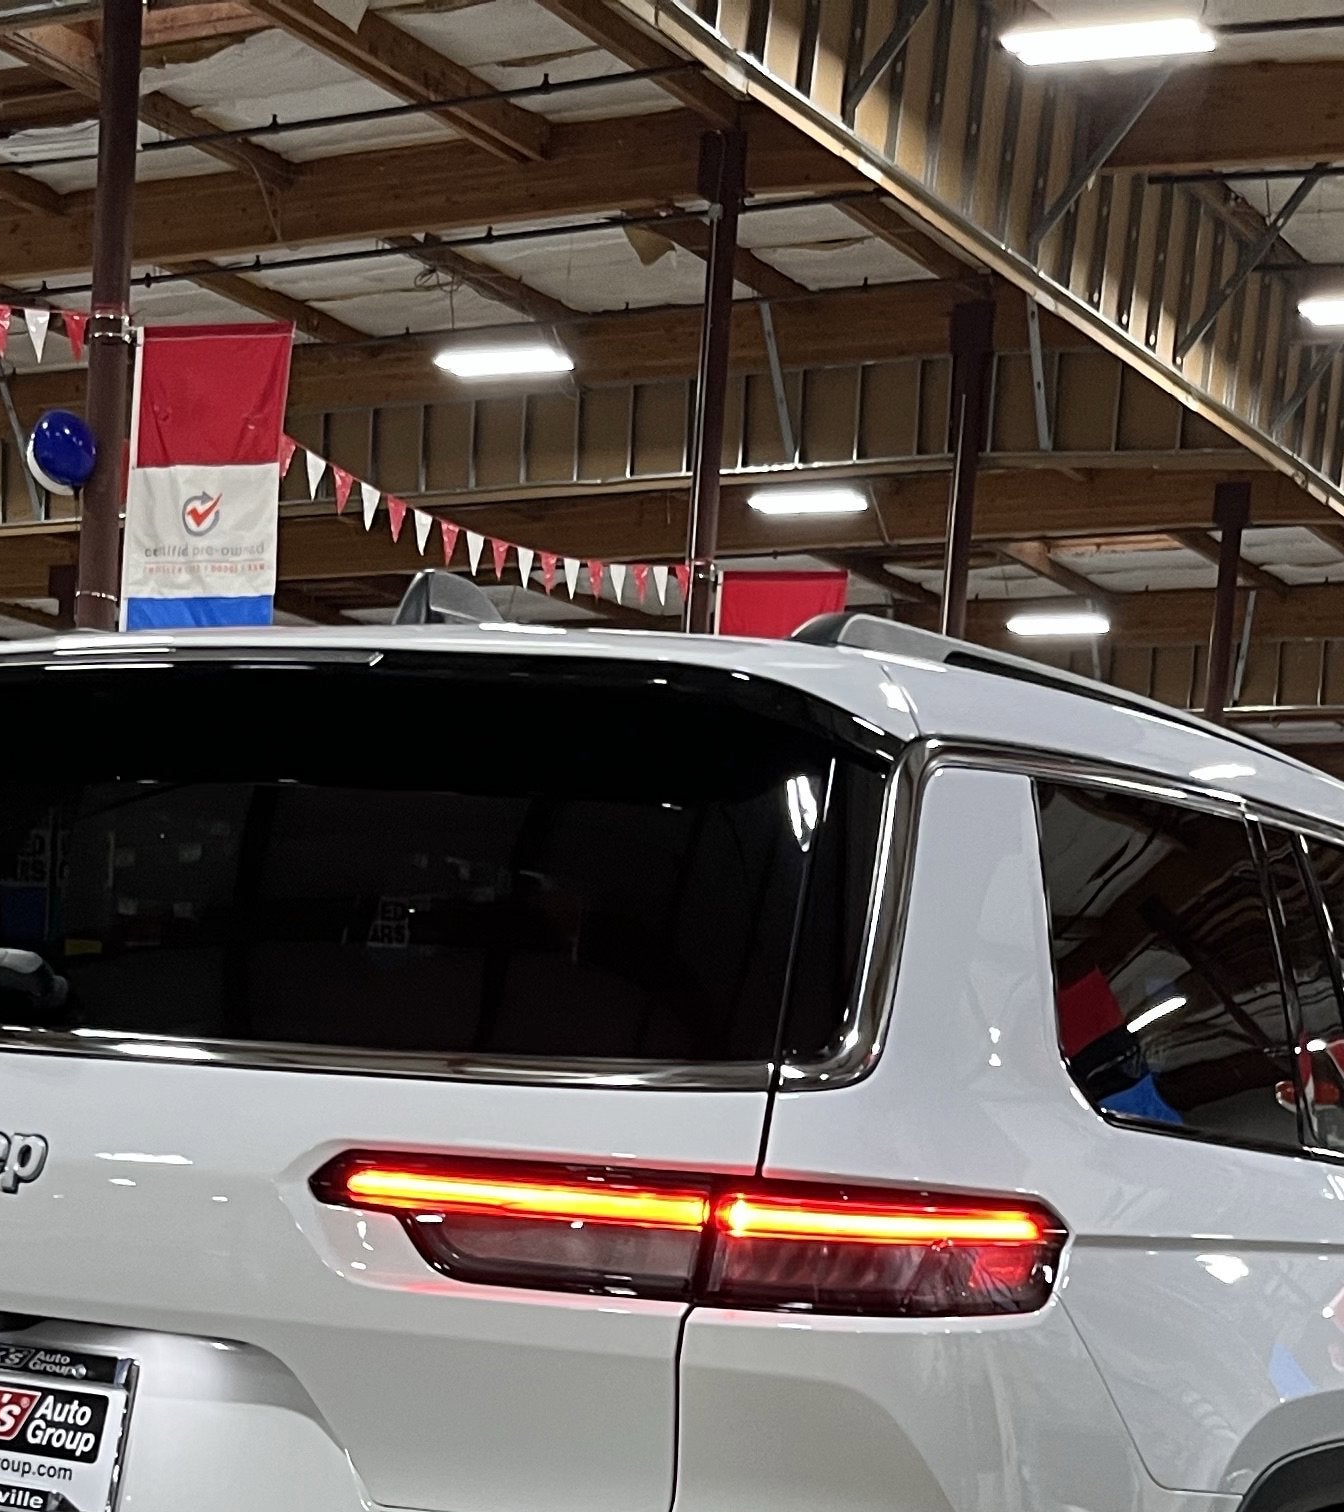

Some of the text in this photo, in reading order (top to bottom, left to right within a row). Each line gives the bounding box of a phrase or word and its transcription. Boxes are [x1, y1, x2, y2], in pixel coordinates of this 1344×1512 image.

[33, 1350, 71, 1365] Auto
[35, 1395, 93, 1426] Auto
[26, 1419, 96, 1457] Group
